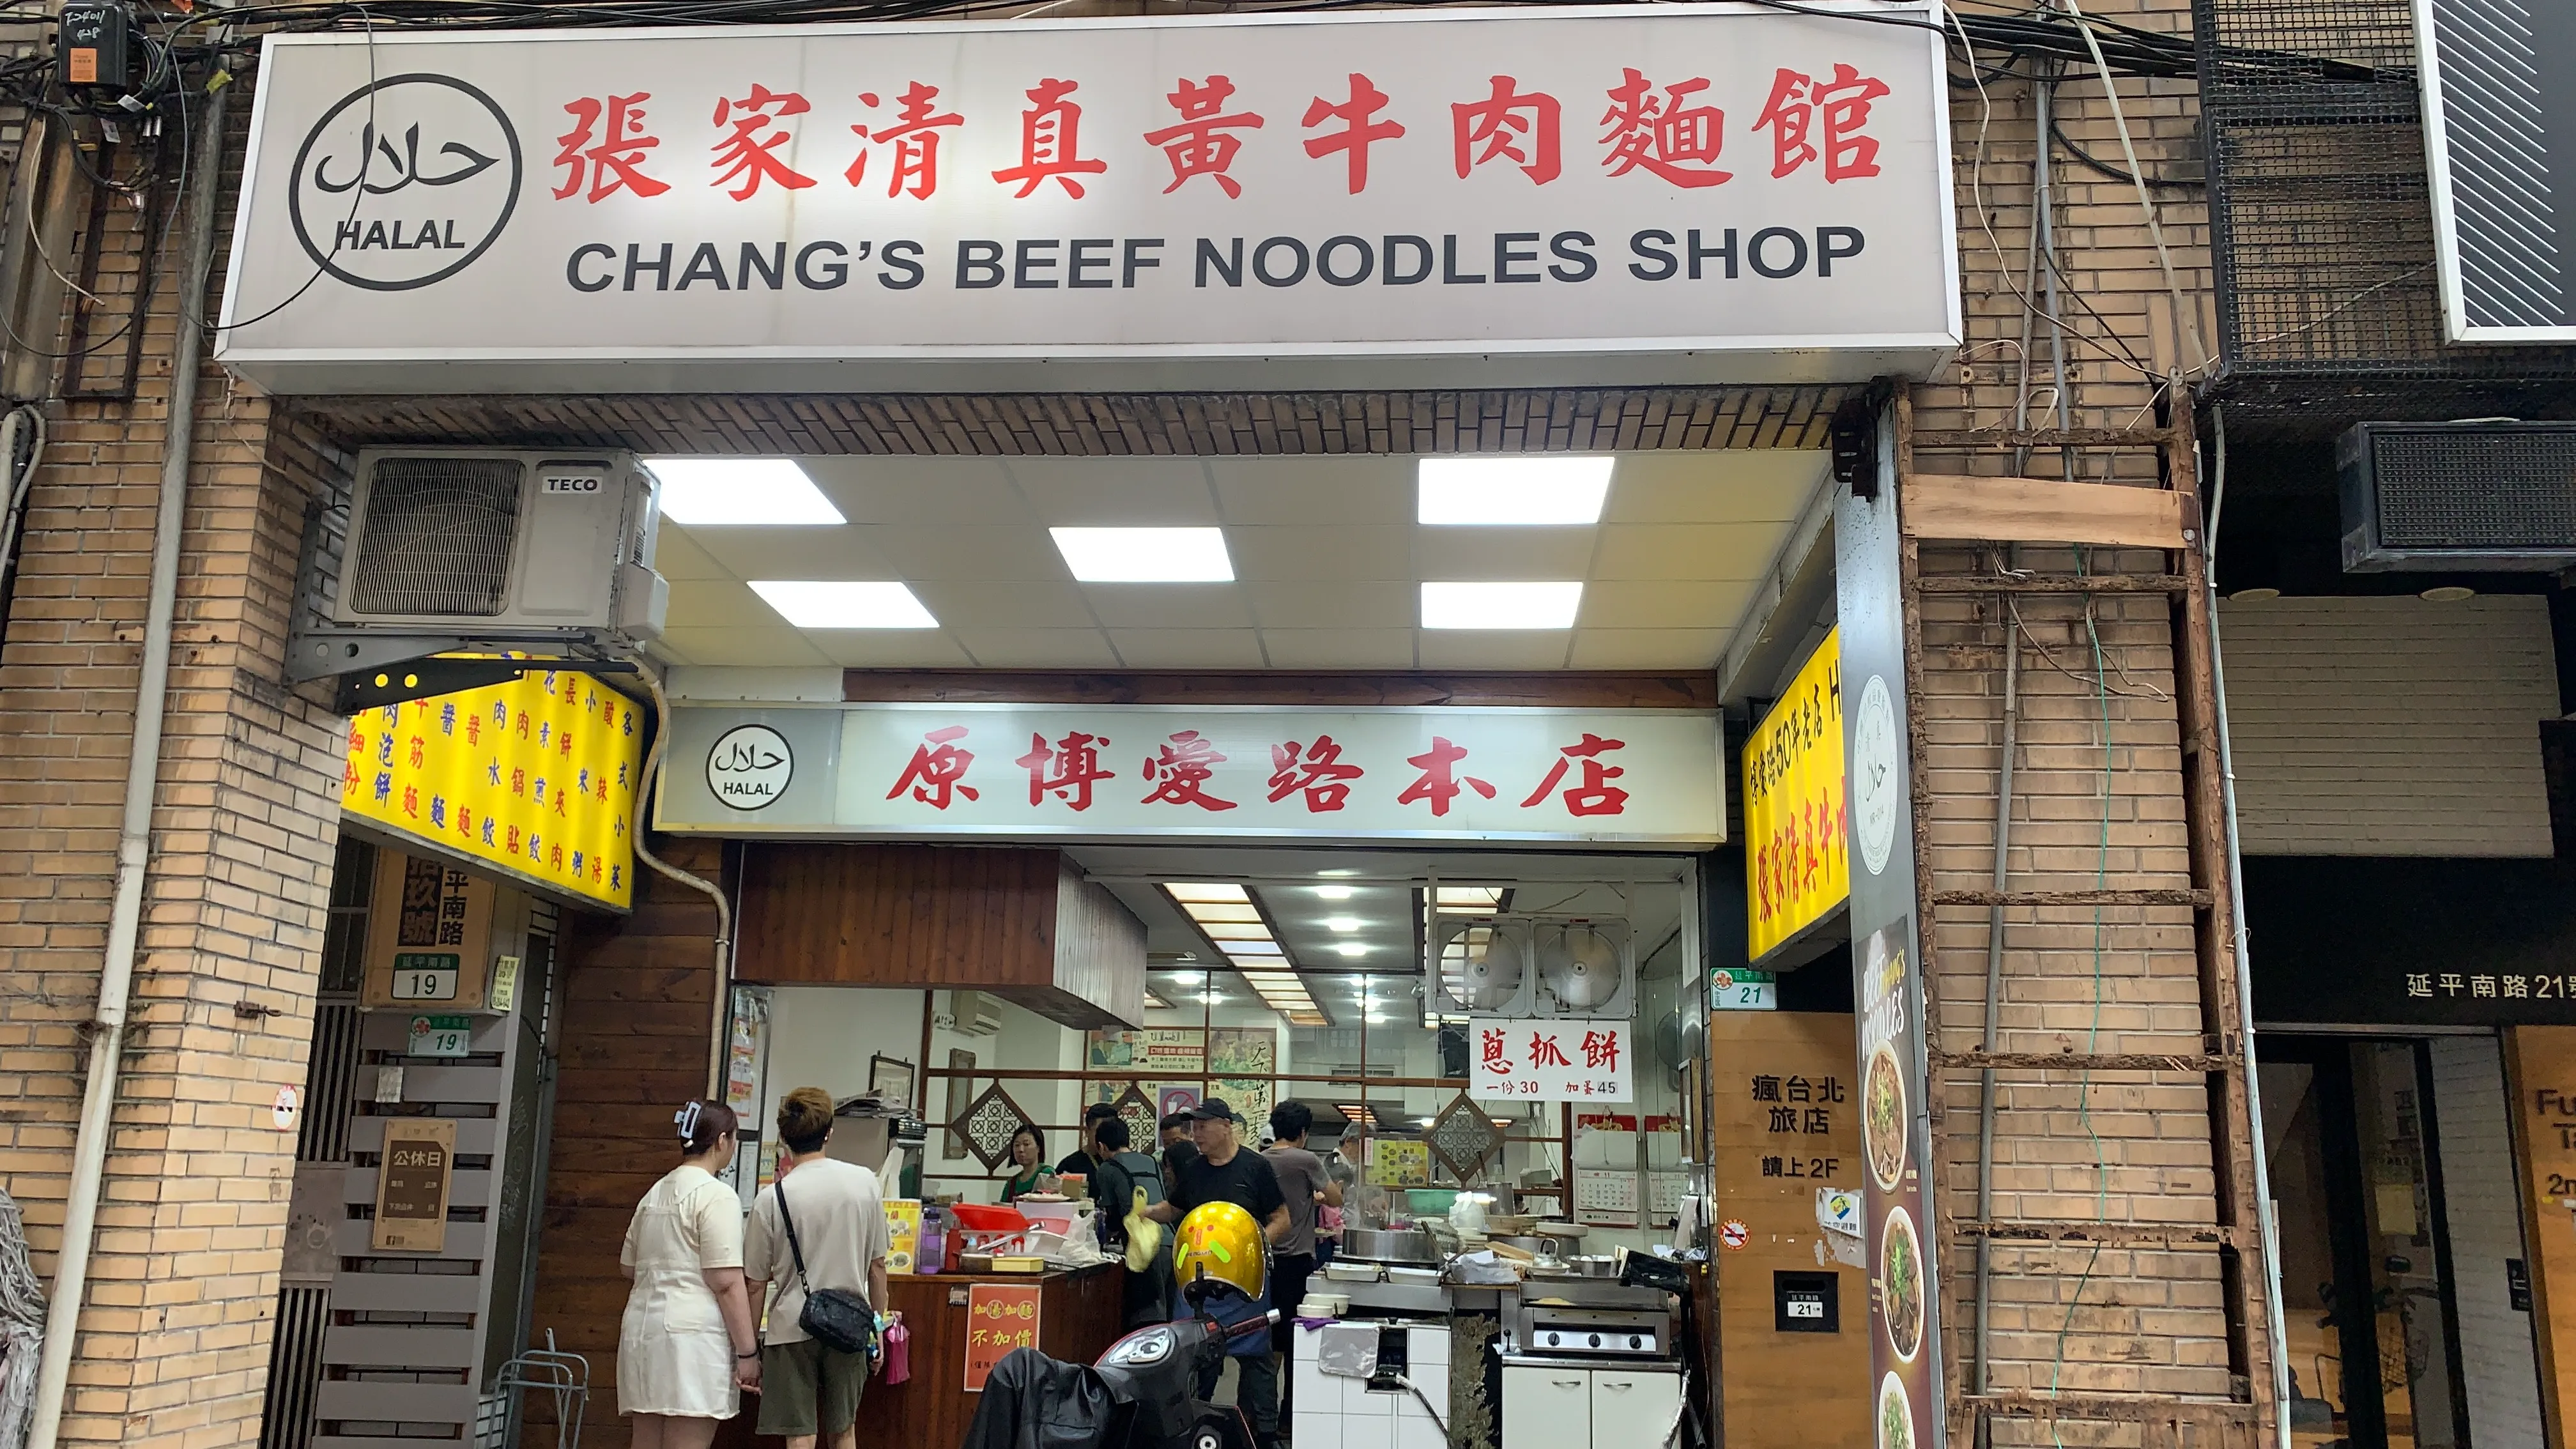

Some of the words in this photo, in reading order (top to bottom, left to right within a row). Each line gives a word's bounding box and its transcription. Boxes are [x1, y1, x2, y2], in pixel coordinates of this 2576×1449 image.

[552, 63, 1891, 203] 張家清真黃牛肉麵館
[315, 121, 500, 194] حلال
[336, 219, 466, 250] HALAL
[566, 240, 925, 293] CHANG'S
[954, 238, 1165, 290] BEEF
[1194, 230, 1598, 288] NOODLES
[1627, 225, 1866, 282] SHOP
[548, 479, 598, 491] TECO
[714, 741, 786, 772] حلال
[887, 726, 1630, 816] 原博愛路本店
[723, 781, 774, 797] HALAL
[411, 974, 437, 995] 19
[1740, 986, 1761, 1004] 21
[436, 1033, 457, 1051] 19
[1482, 1028, 1620, 1075] 蔥抓餅
[1751, 1075, 1844, 1103] 瘋台北
[1768, 1106, 1830, 1135] 旅店
[393, 1151, 441, 1167] 公休日
[1797, 1303, 1811, 1315] 21
